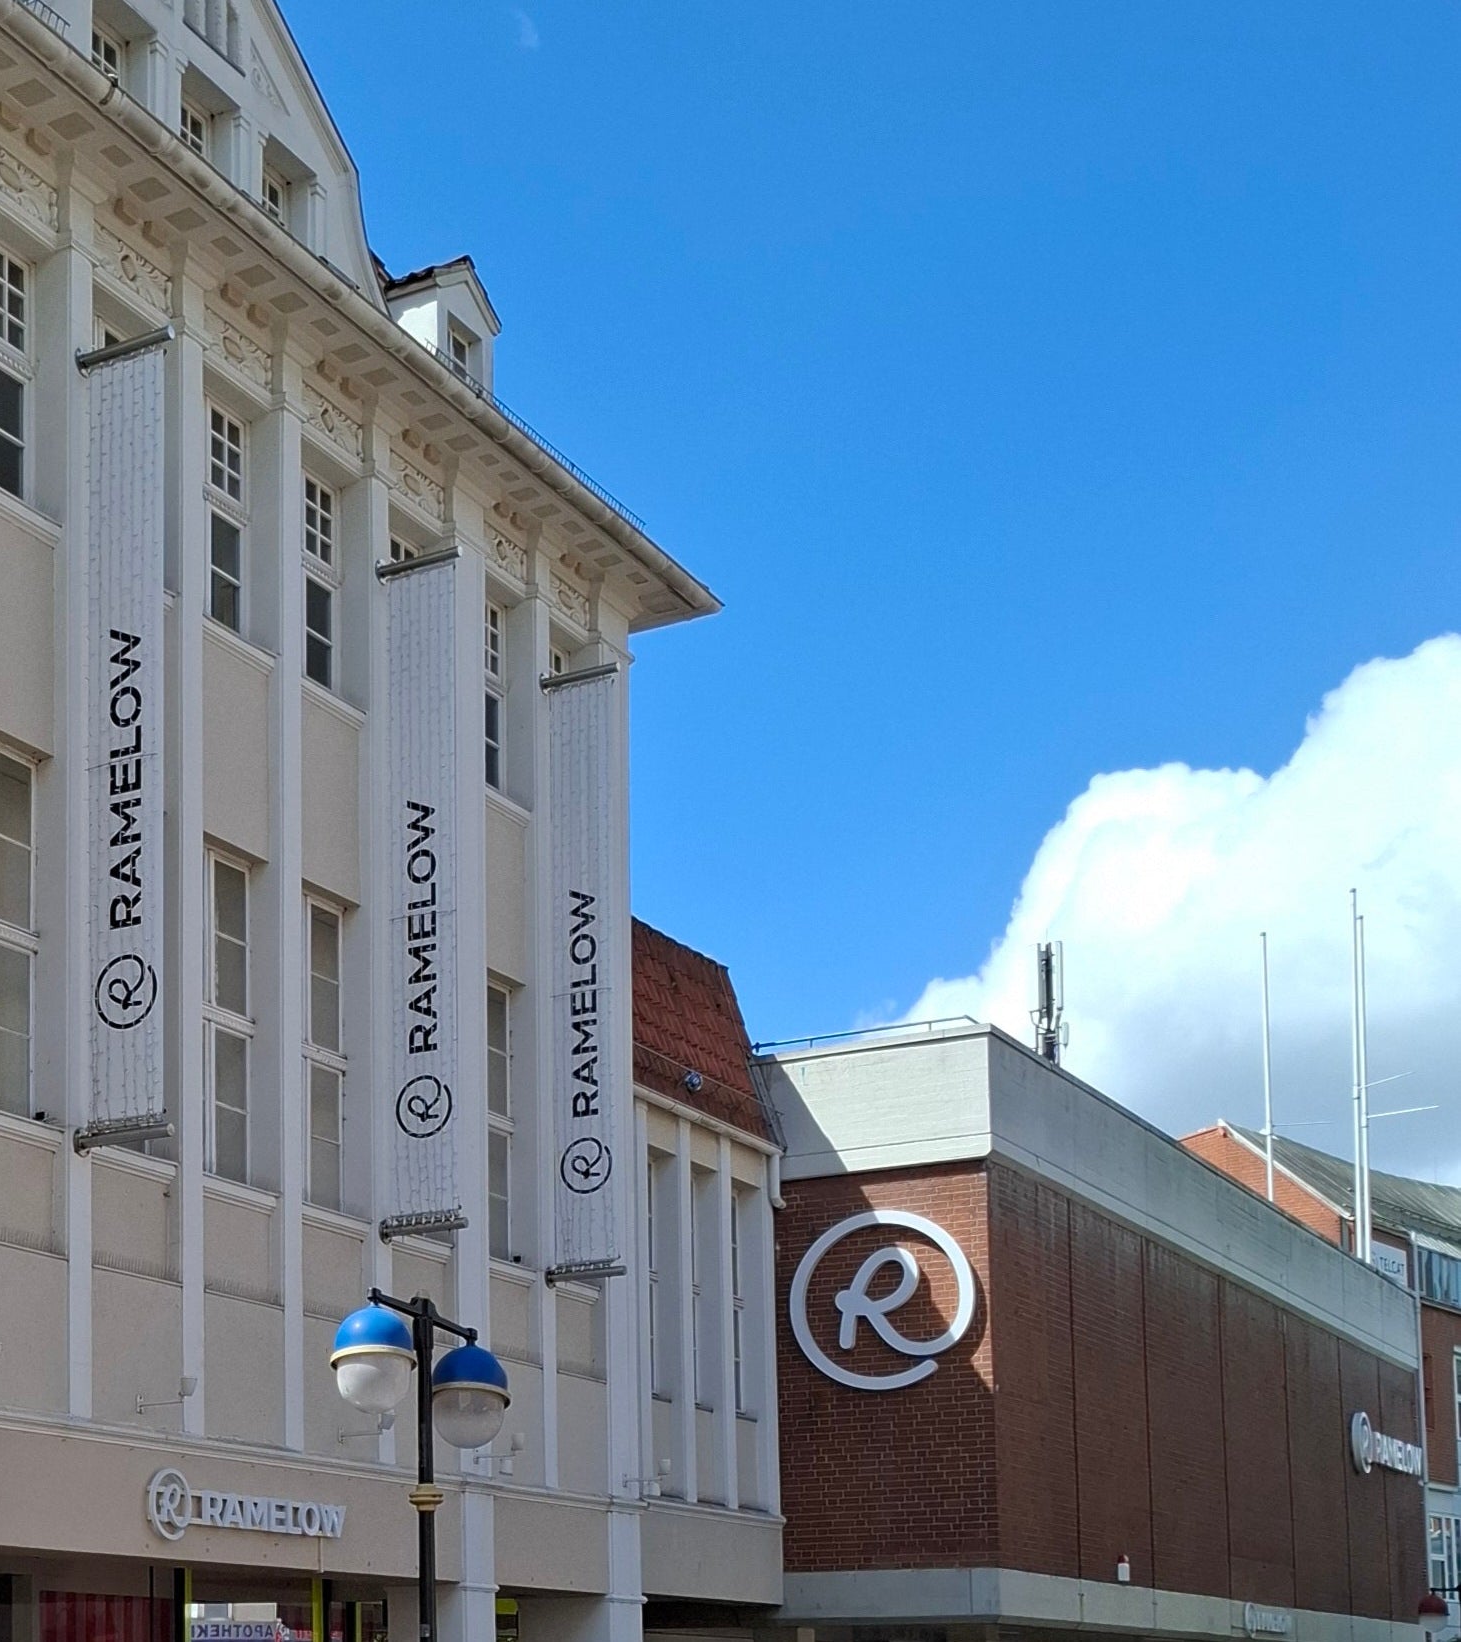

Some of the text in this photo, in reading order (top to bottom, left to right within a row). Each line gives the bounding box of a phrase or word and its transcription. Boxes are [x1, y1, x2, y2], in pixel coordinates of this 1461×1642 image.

[109, 629, 142, 930] RAMELOW
[406, 800, 438, 1055] RAMELOW
[569, 889, 599, 1118] RAMELOW
[201, 1489, 347, 1538] RAMELOW
[1372, 1431, 1422, 1476] RAMELOW
